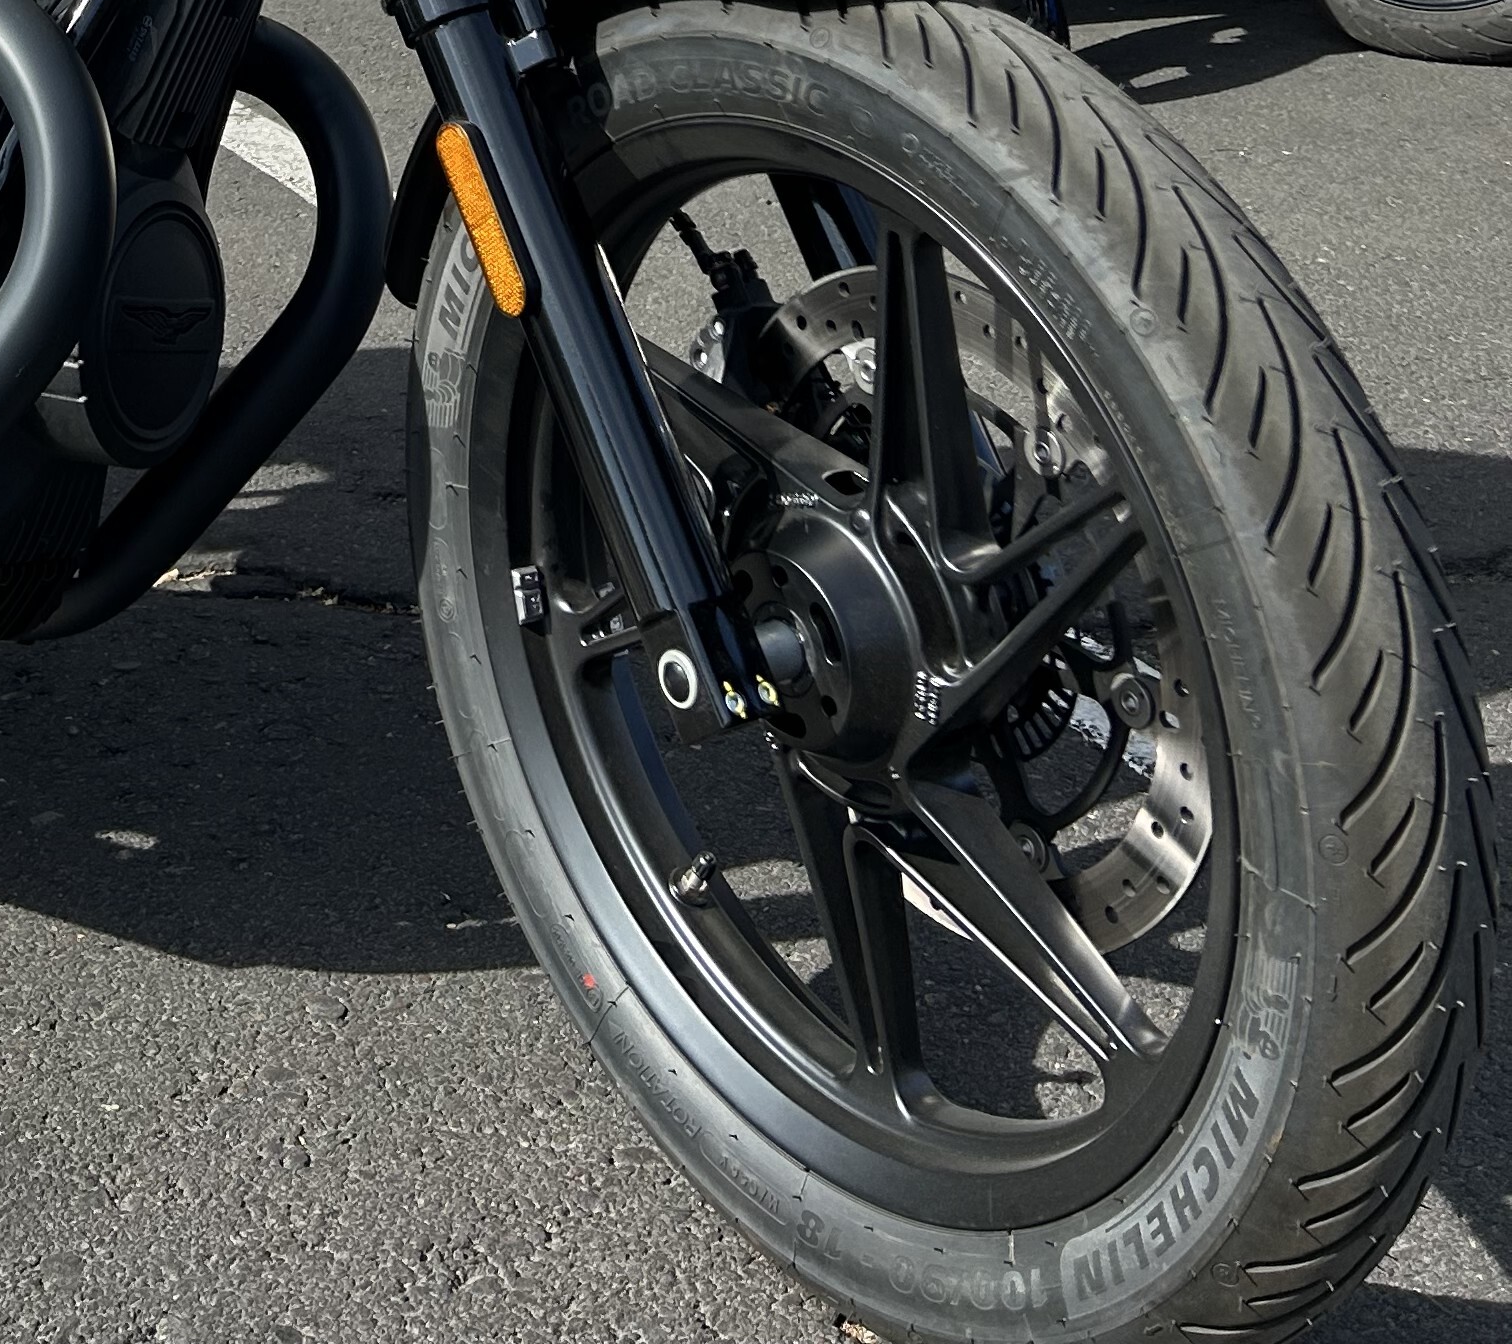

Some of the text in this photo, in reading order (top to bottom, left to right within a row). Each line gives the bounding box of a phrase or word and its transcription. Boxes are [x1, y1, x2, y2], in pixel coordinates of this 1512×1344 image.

[667, 63, 832, 119] CLASSIC
[611, 1030, 702, 1140] ROTATION
[1073, 1065, 1260, 1302] MICHELIN
